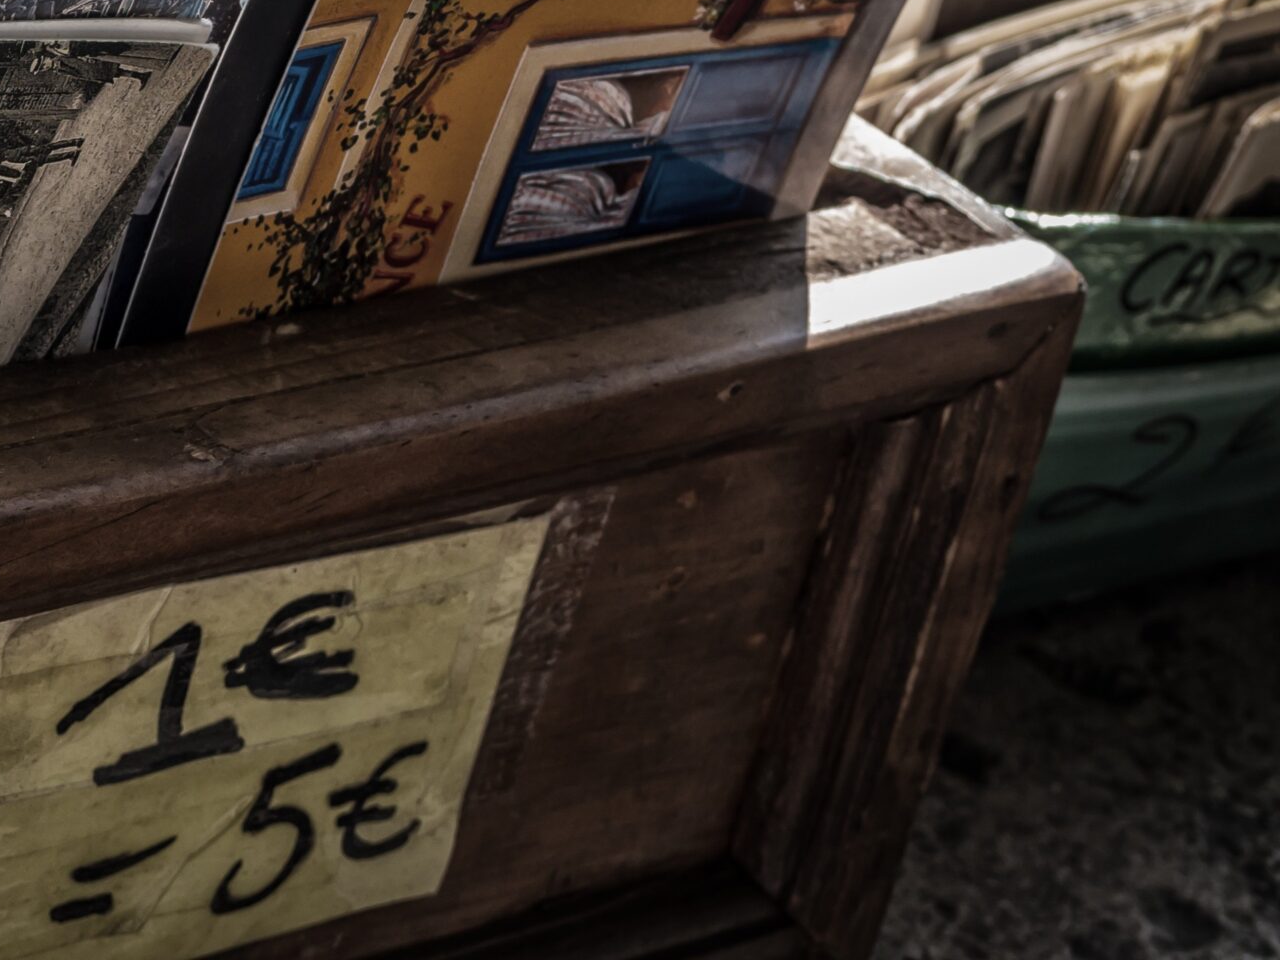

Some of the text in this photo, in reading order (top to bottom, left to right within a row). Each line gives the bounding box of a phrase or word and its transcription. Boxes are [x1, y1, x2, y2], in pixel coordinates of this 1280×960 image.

[56, 591, 360, 787] 1€
[49, 836, 178, 922] =
[211, 742, 429, 915] 5€
